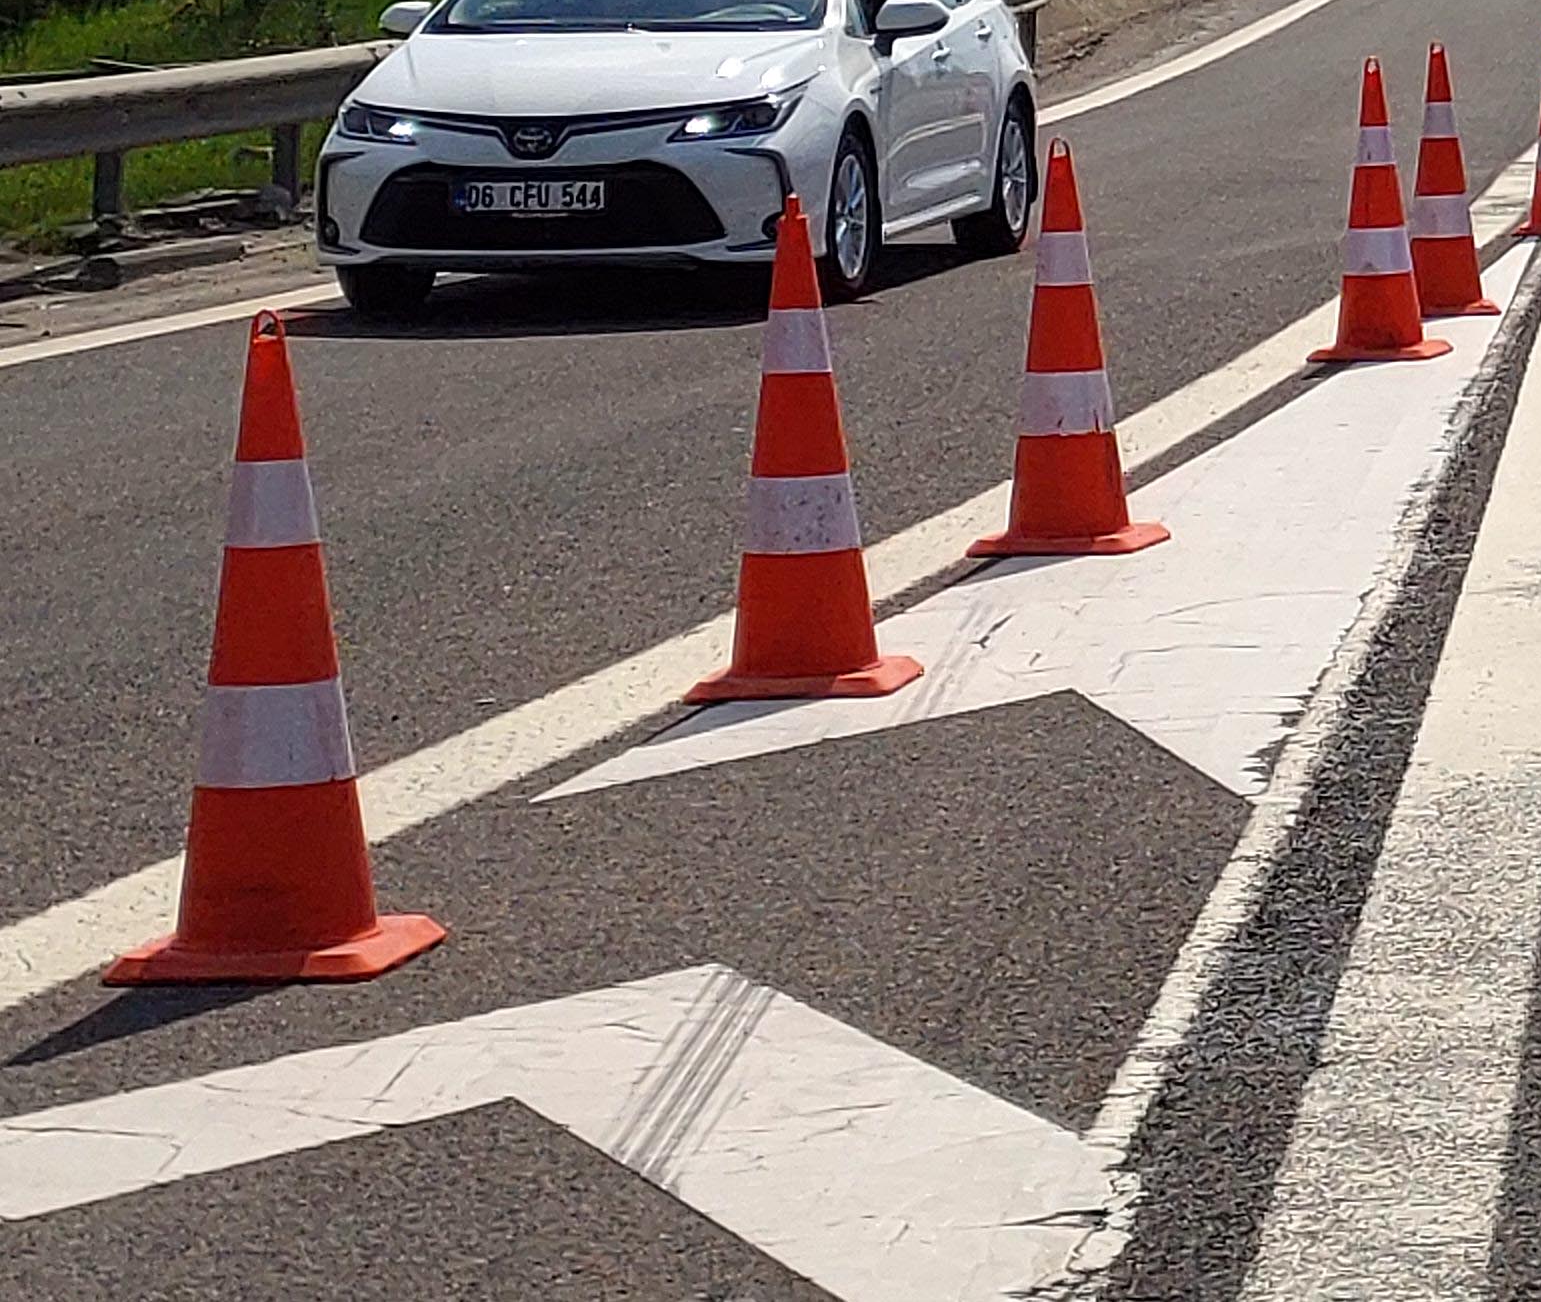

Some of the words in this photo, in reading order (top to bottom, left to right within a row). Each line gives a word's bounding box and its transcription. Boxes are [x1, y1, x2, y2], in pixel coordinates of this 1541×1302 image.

[467, 185, 495, 208] 06
[509, 184, 550, 208] CFU
[561, 183, 601, 208] 544
